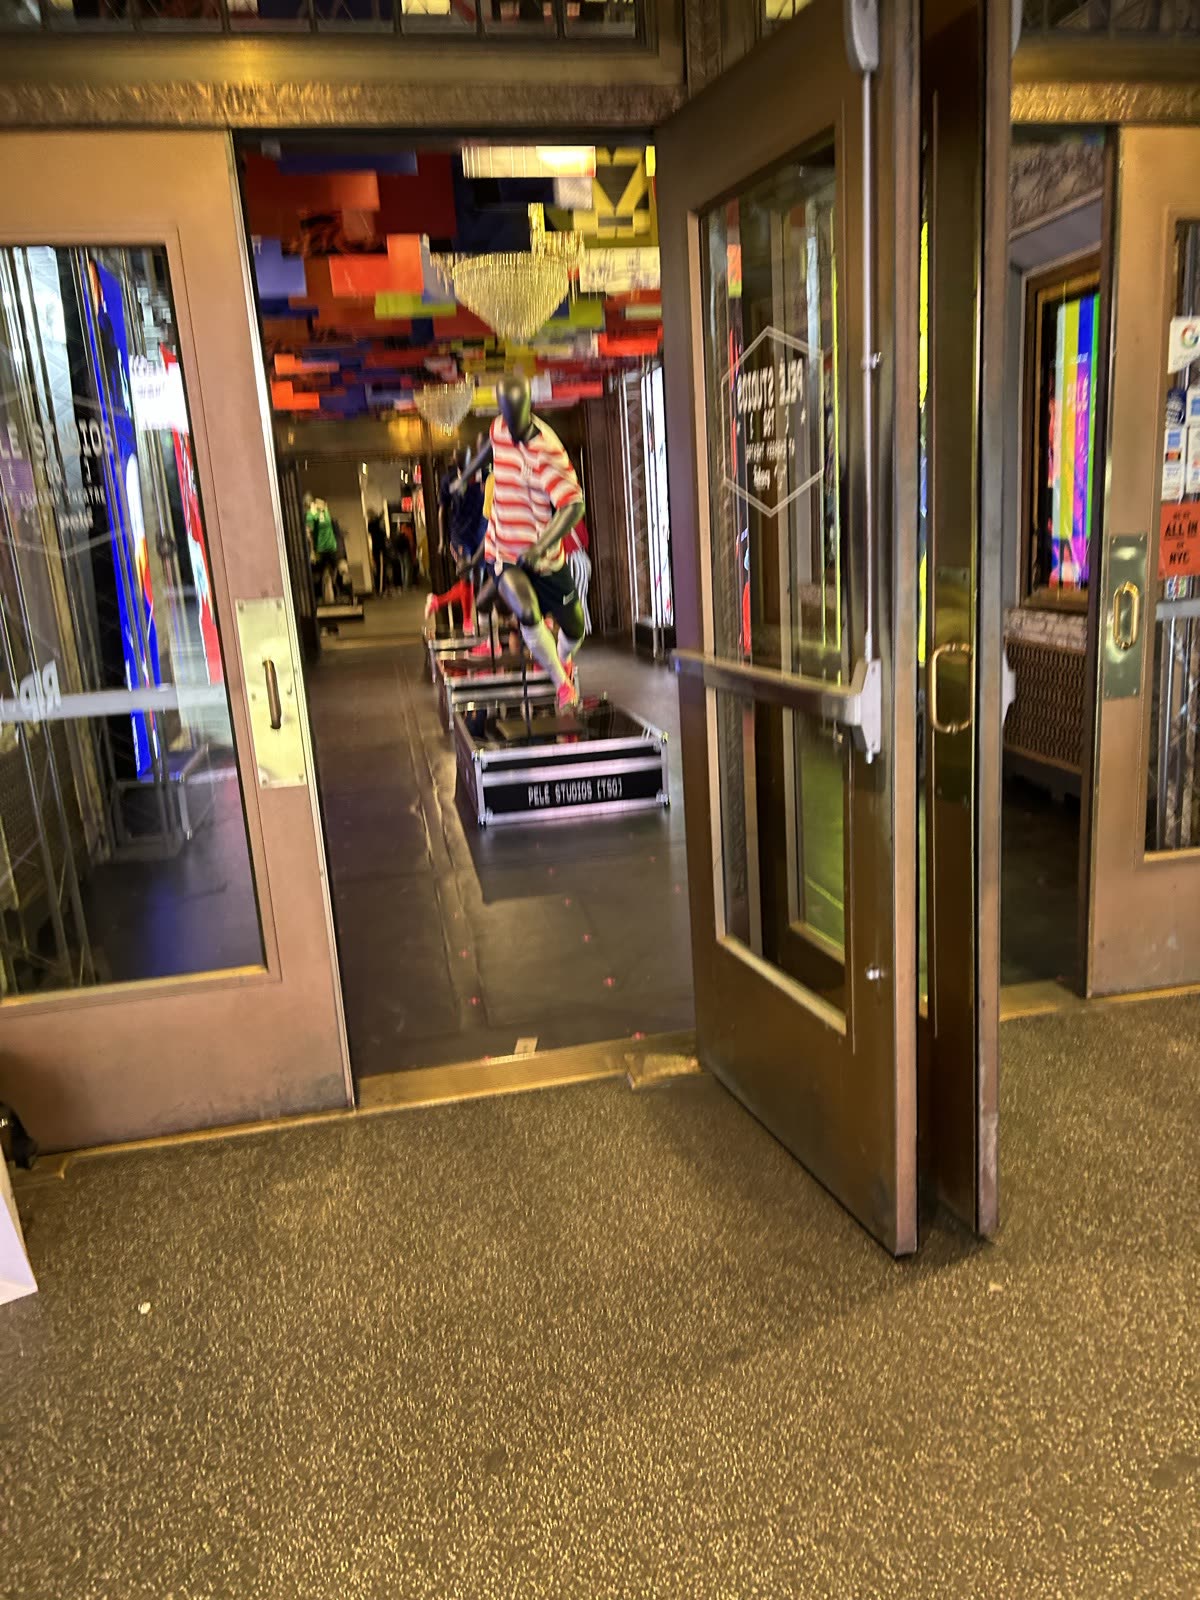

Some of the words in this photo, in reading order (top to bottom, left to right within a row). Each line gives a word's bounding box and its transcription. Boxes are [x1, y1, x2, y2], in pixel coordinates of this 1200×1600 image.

[1165, 521, 1184, 537] ALL
[1187, 519, 1199, 537] IN
[1169, 551, 1190, 565] NYC
[555, 780, 593, 804] STUDIOS
